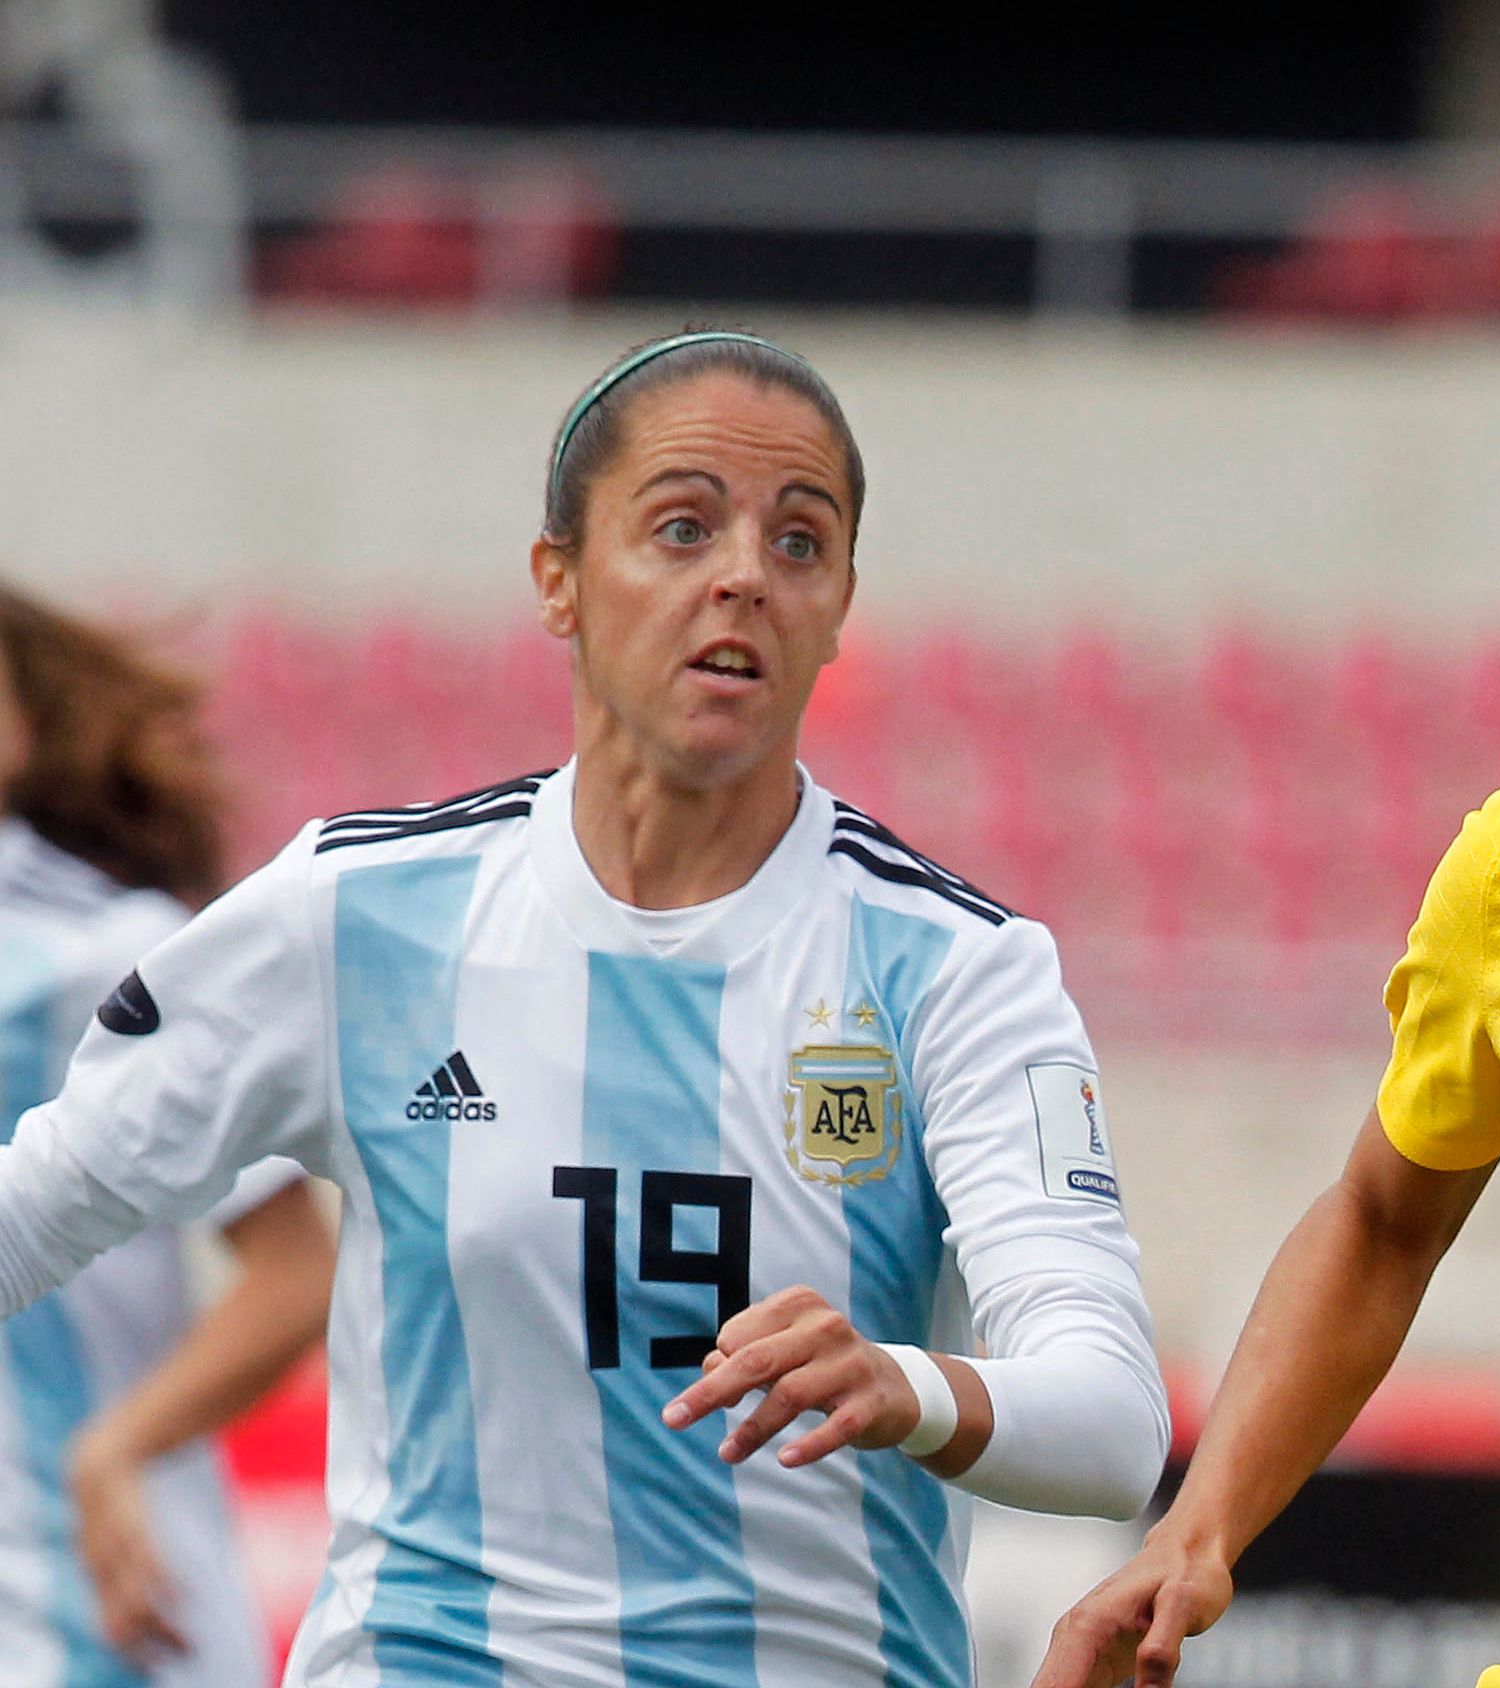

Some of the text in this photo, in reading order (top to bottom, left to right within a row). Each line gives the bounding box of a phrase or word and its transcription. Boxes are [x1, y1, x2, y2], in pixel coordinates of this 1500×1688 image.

[406, 1097, 497, 1121] adidas
[811, 1083, 876, 1144] AFA
[553, 1166, 752, 1369] 19
